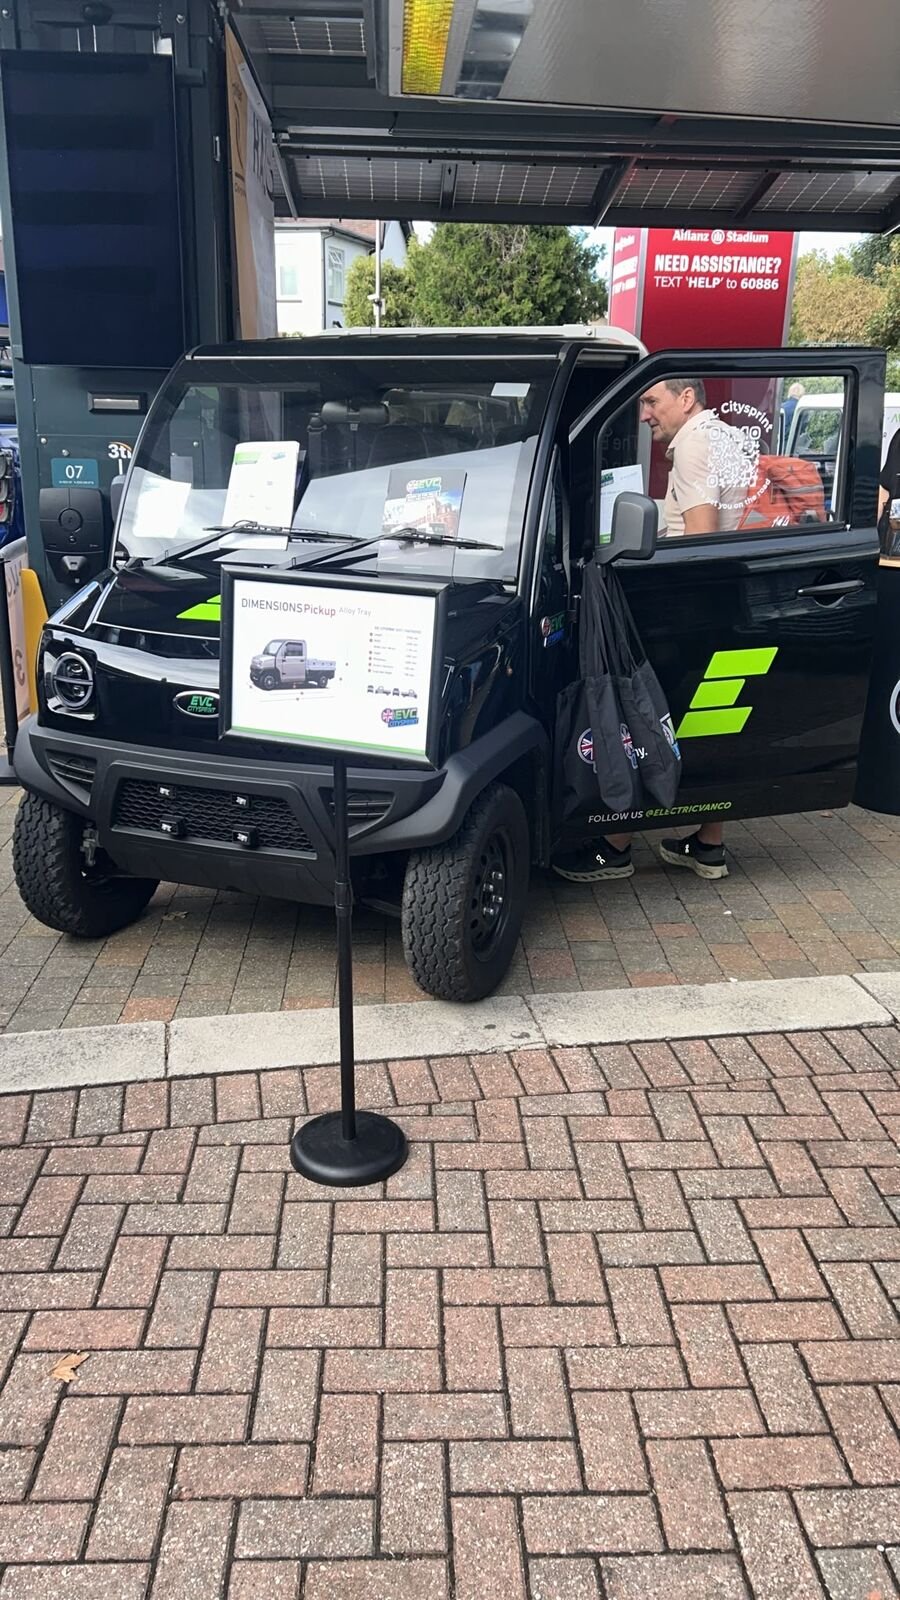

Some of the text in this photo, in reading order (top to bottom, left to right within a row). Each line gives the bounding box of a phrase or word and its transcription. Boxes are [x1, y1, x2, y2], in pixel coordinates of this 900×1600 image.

[726, 230, 769, 243] Stadium
[655, 254, 689, 272] NEED
[691, 255, 782, 275] ASSISTANCE?
[654, 276, 683, 288] TEXT
[726, 278, 738, 289] to
[740, 278, 779, 290] 60886
[721, 401, 774, 433] Citysprint
[65, 465, 84, 480] 07
[717, 502, 733, 510] you
[744, 495, 757, 505] the
[757, 478, 772, 497] road
[241, 598, 372, 618] DIMENSIONS Pickup Alloy Tray
[190, 695, 214, 707] EVC
[395, 709, 418, 720] EVC
[588, 801, 732, 823] FOLLOW US @ELECTRICVANCO
